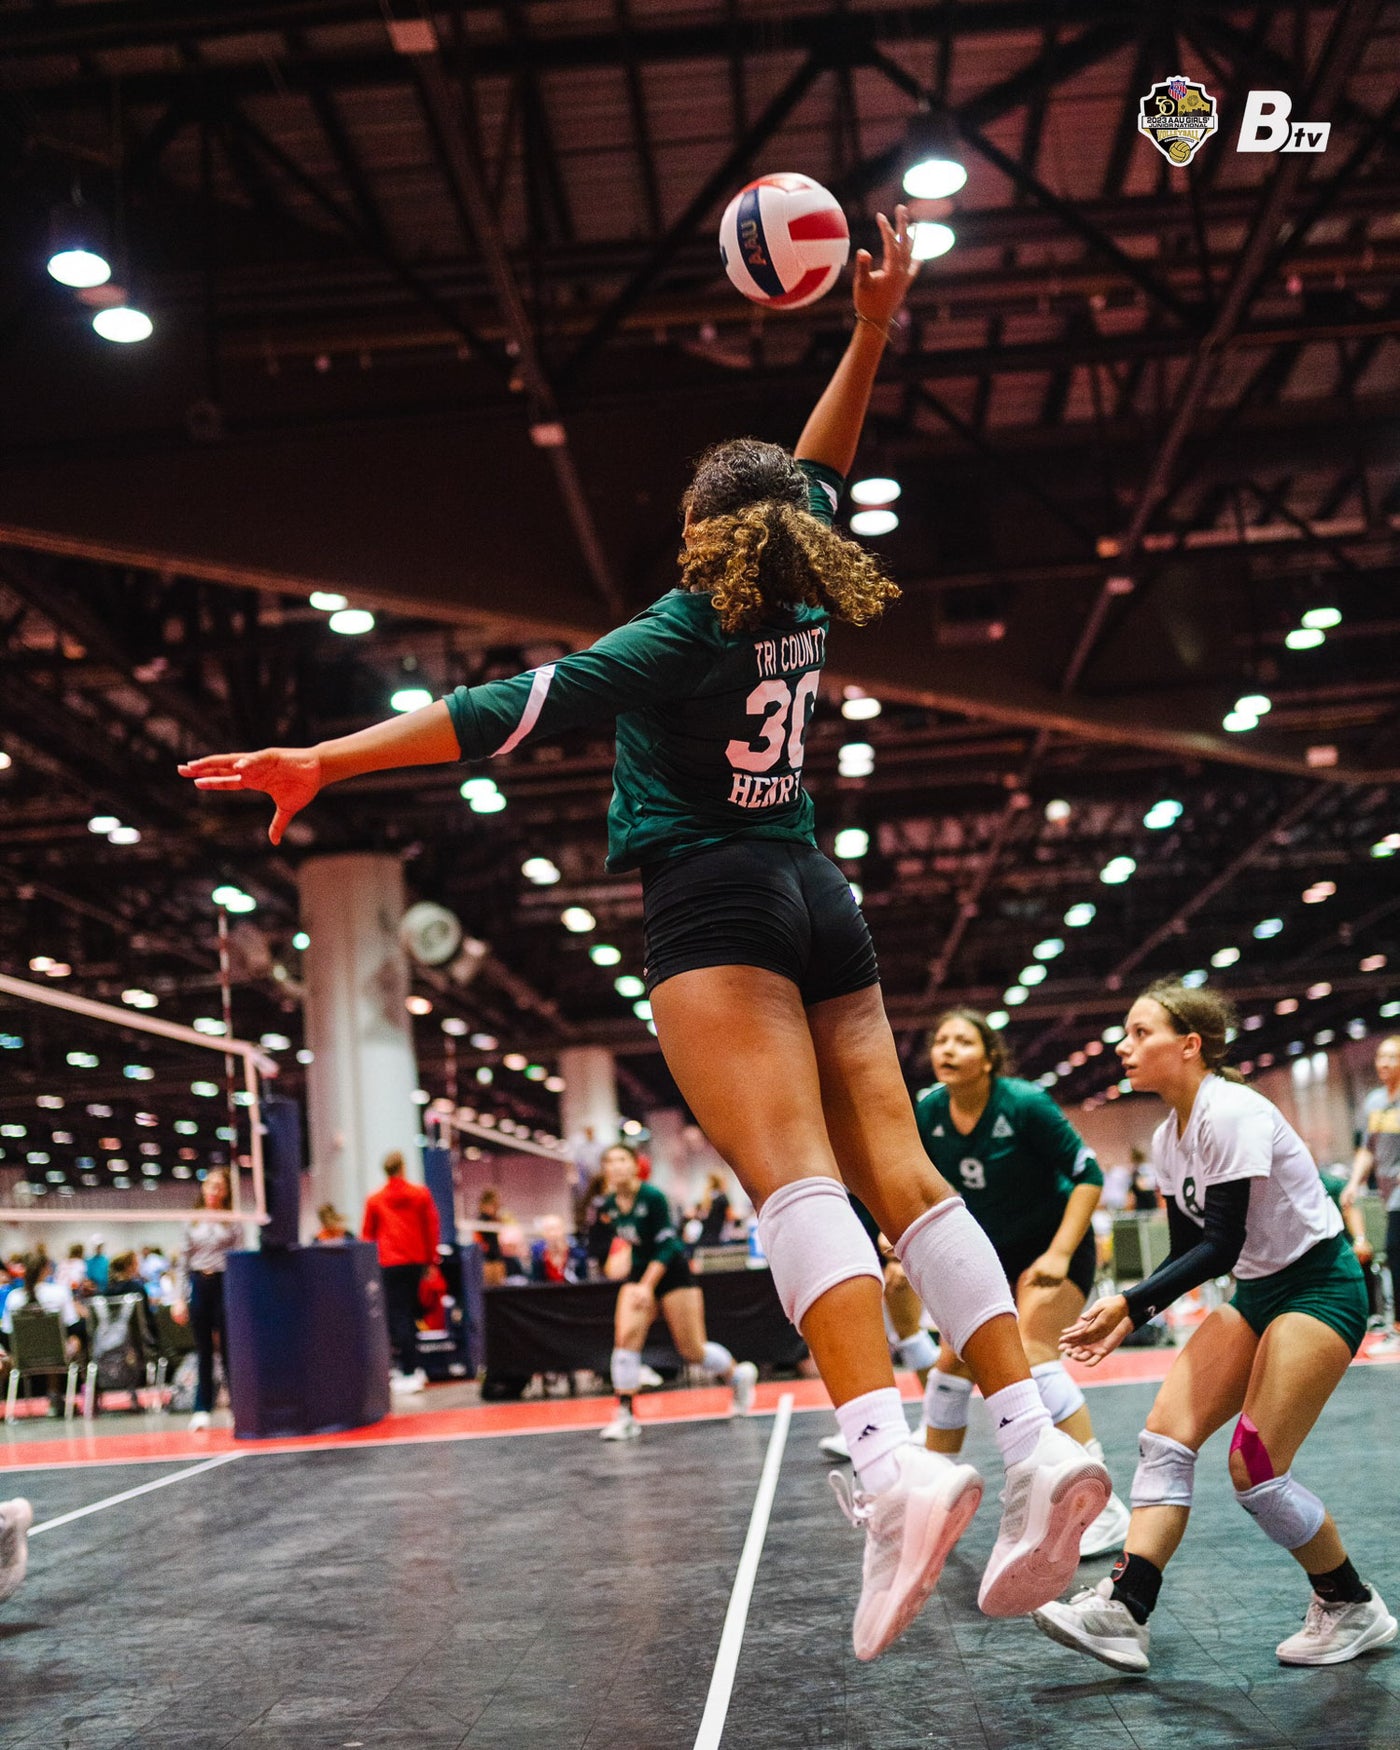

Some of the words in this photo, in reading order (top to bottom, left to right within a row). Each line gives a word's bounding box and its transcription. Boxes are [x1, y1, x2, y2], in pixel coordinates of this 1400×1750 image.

[741, 220, 767, 265] AAU
[754, 639, 777, 678] TRI
[959, 1157, 986, 1190] 9
